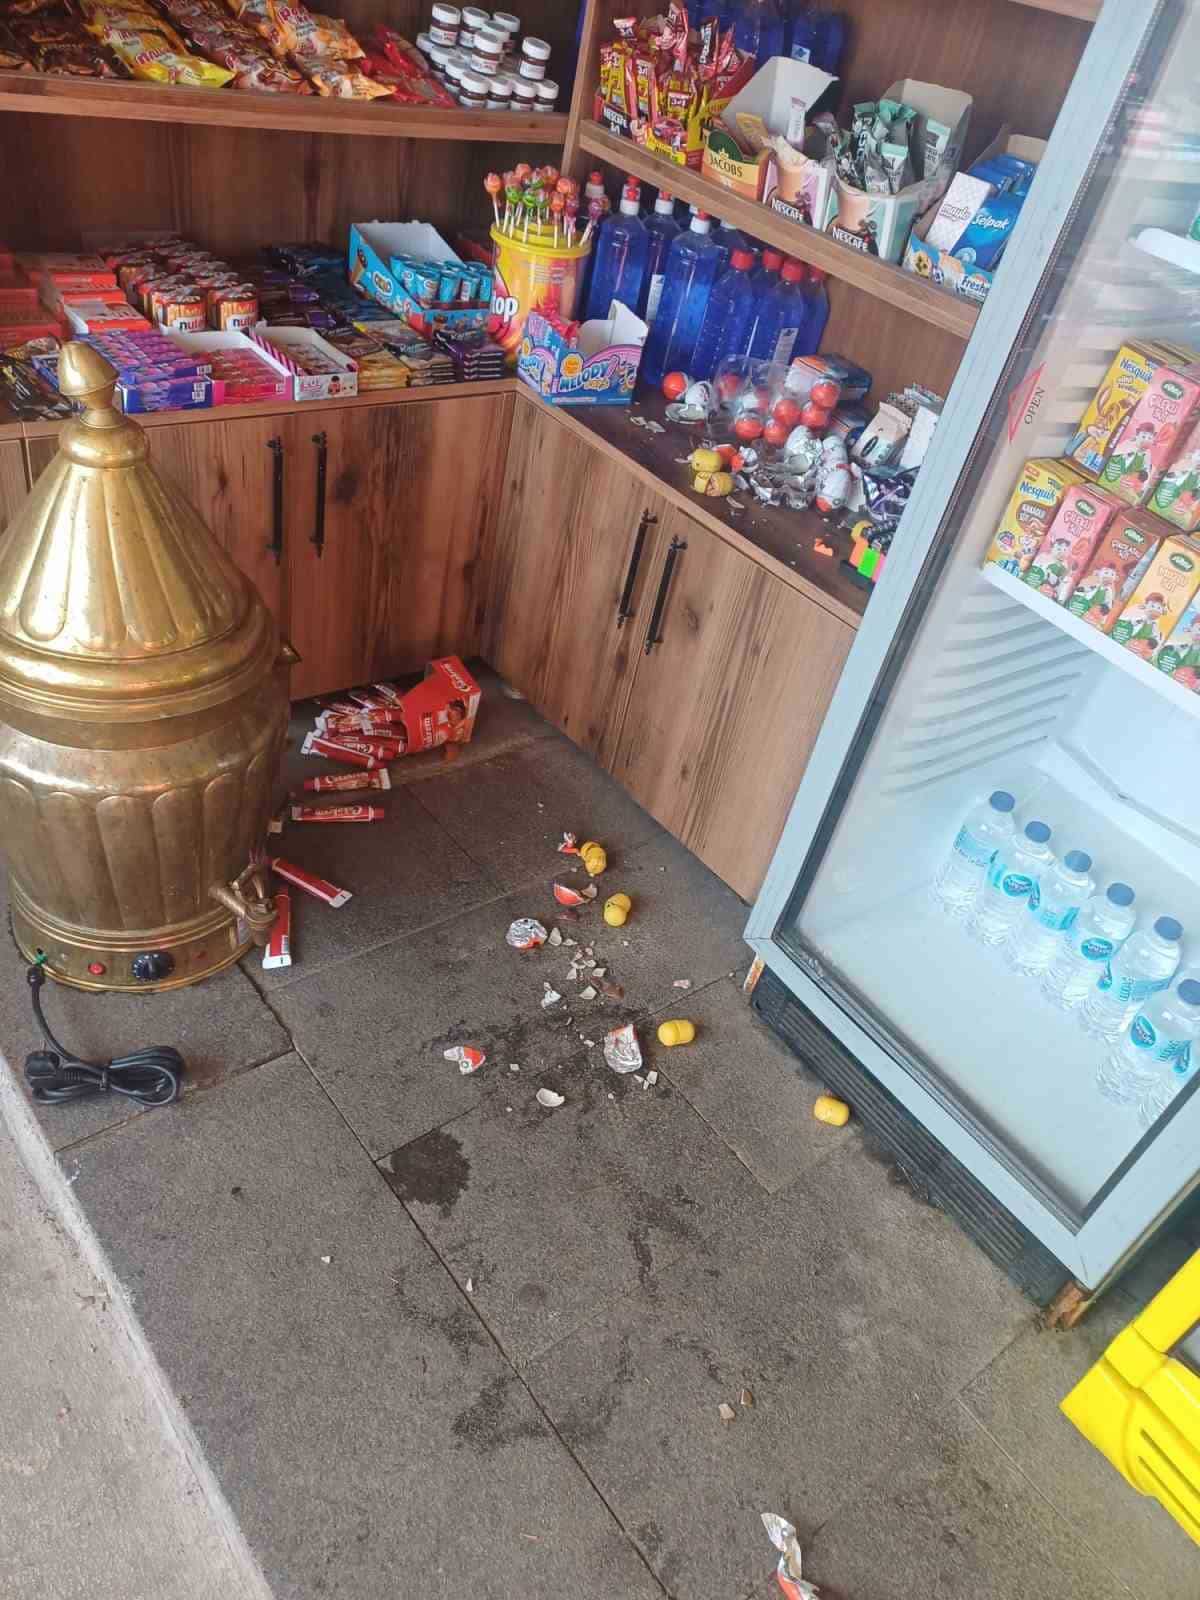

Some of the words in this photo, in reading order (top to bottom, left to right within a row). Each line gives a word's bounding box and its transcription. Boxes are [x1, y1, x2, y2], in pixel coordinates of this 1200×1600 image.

[709, 153, 744, 178] JACOBS
[559, 360, 609, 393] MELODY
[1024, 388, 1046, 425] OPEN
[1019, 480, 1056, 501] Nesquik
